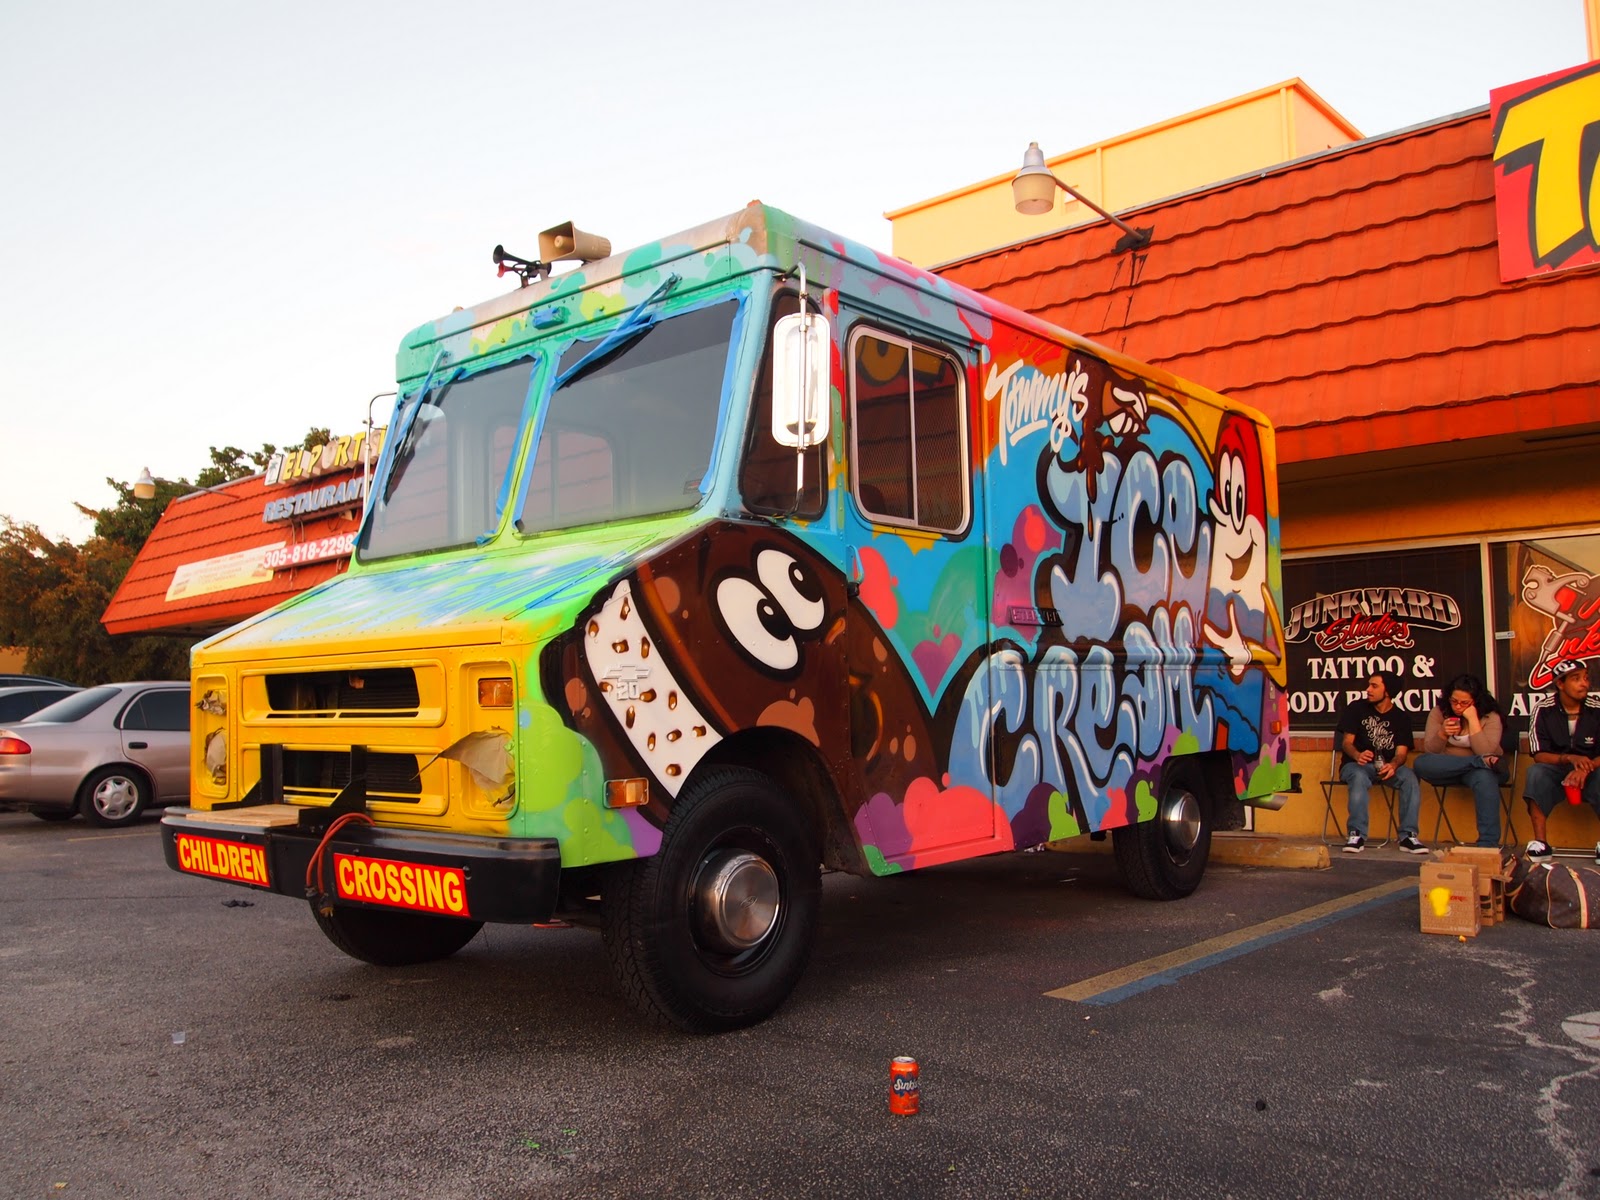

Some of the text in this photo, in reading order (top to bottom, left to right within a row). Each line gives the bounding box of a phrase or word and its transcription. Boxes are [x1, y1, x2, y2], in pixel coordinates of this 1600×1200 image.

[1493, 69, 1600, 261] T
[984, 359, 1089, 466] Tommy's
[307, 424, 388, 475] PORT
[264, 533, 354, 568] 305-818-2298
[1284, 587, 1461, 643] JUNKYARD
[1315, 612, 1414, 652] Studios
[1307, 654, 1435, 680] TATTOO &
[616, 681, 640, 701] 20
[1287, 690, 1339, 713] ODY
[178, 838, 463, 912] CHILDREN CROSSING
[893, 1078, 918, 1091] Sunk
